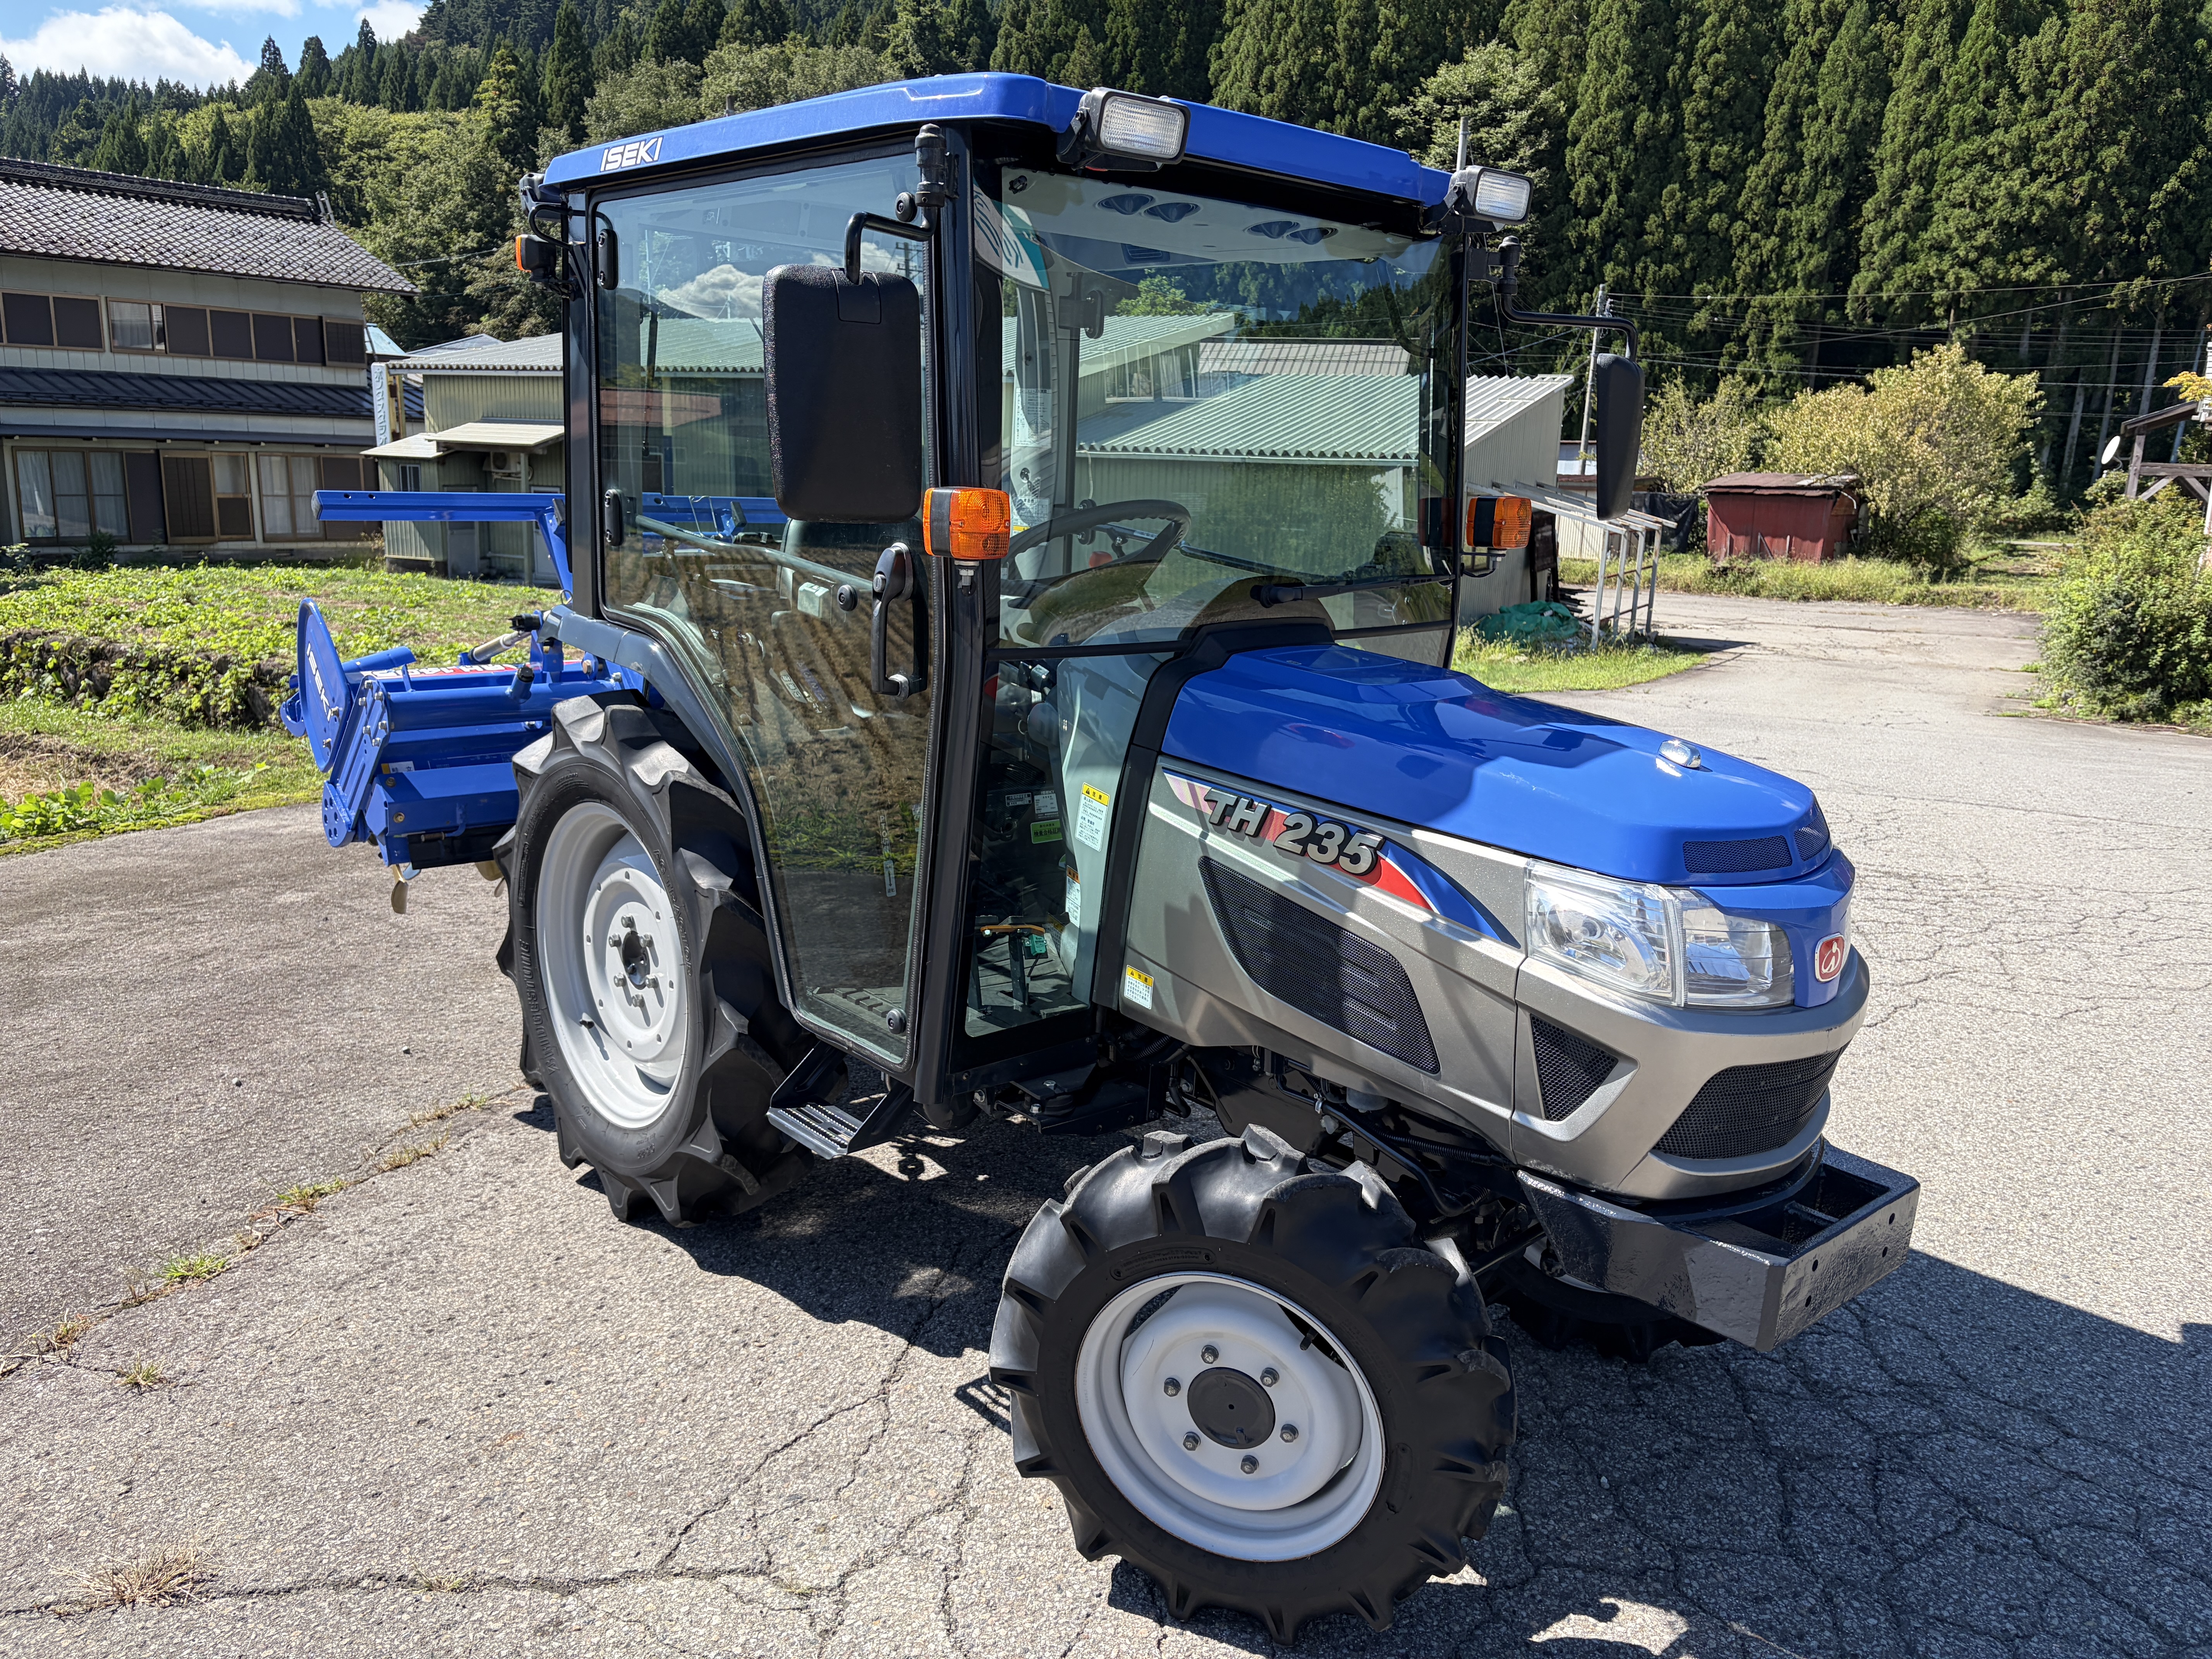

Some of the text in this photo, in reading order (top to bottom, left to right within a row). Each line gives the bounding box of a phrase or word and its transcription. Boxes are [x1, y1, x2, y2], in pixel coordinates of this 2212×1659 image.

[600, 136, 664, 172] ISEKI
[306, 642, 332, 722] ISEKI
[1204, 787, 1385, 876] TH 235
